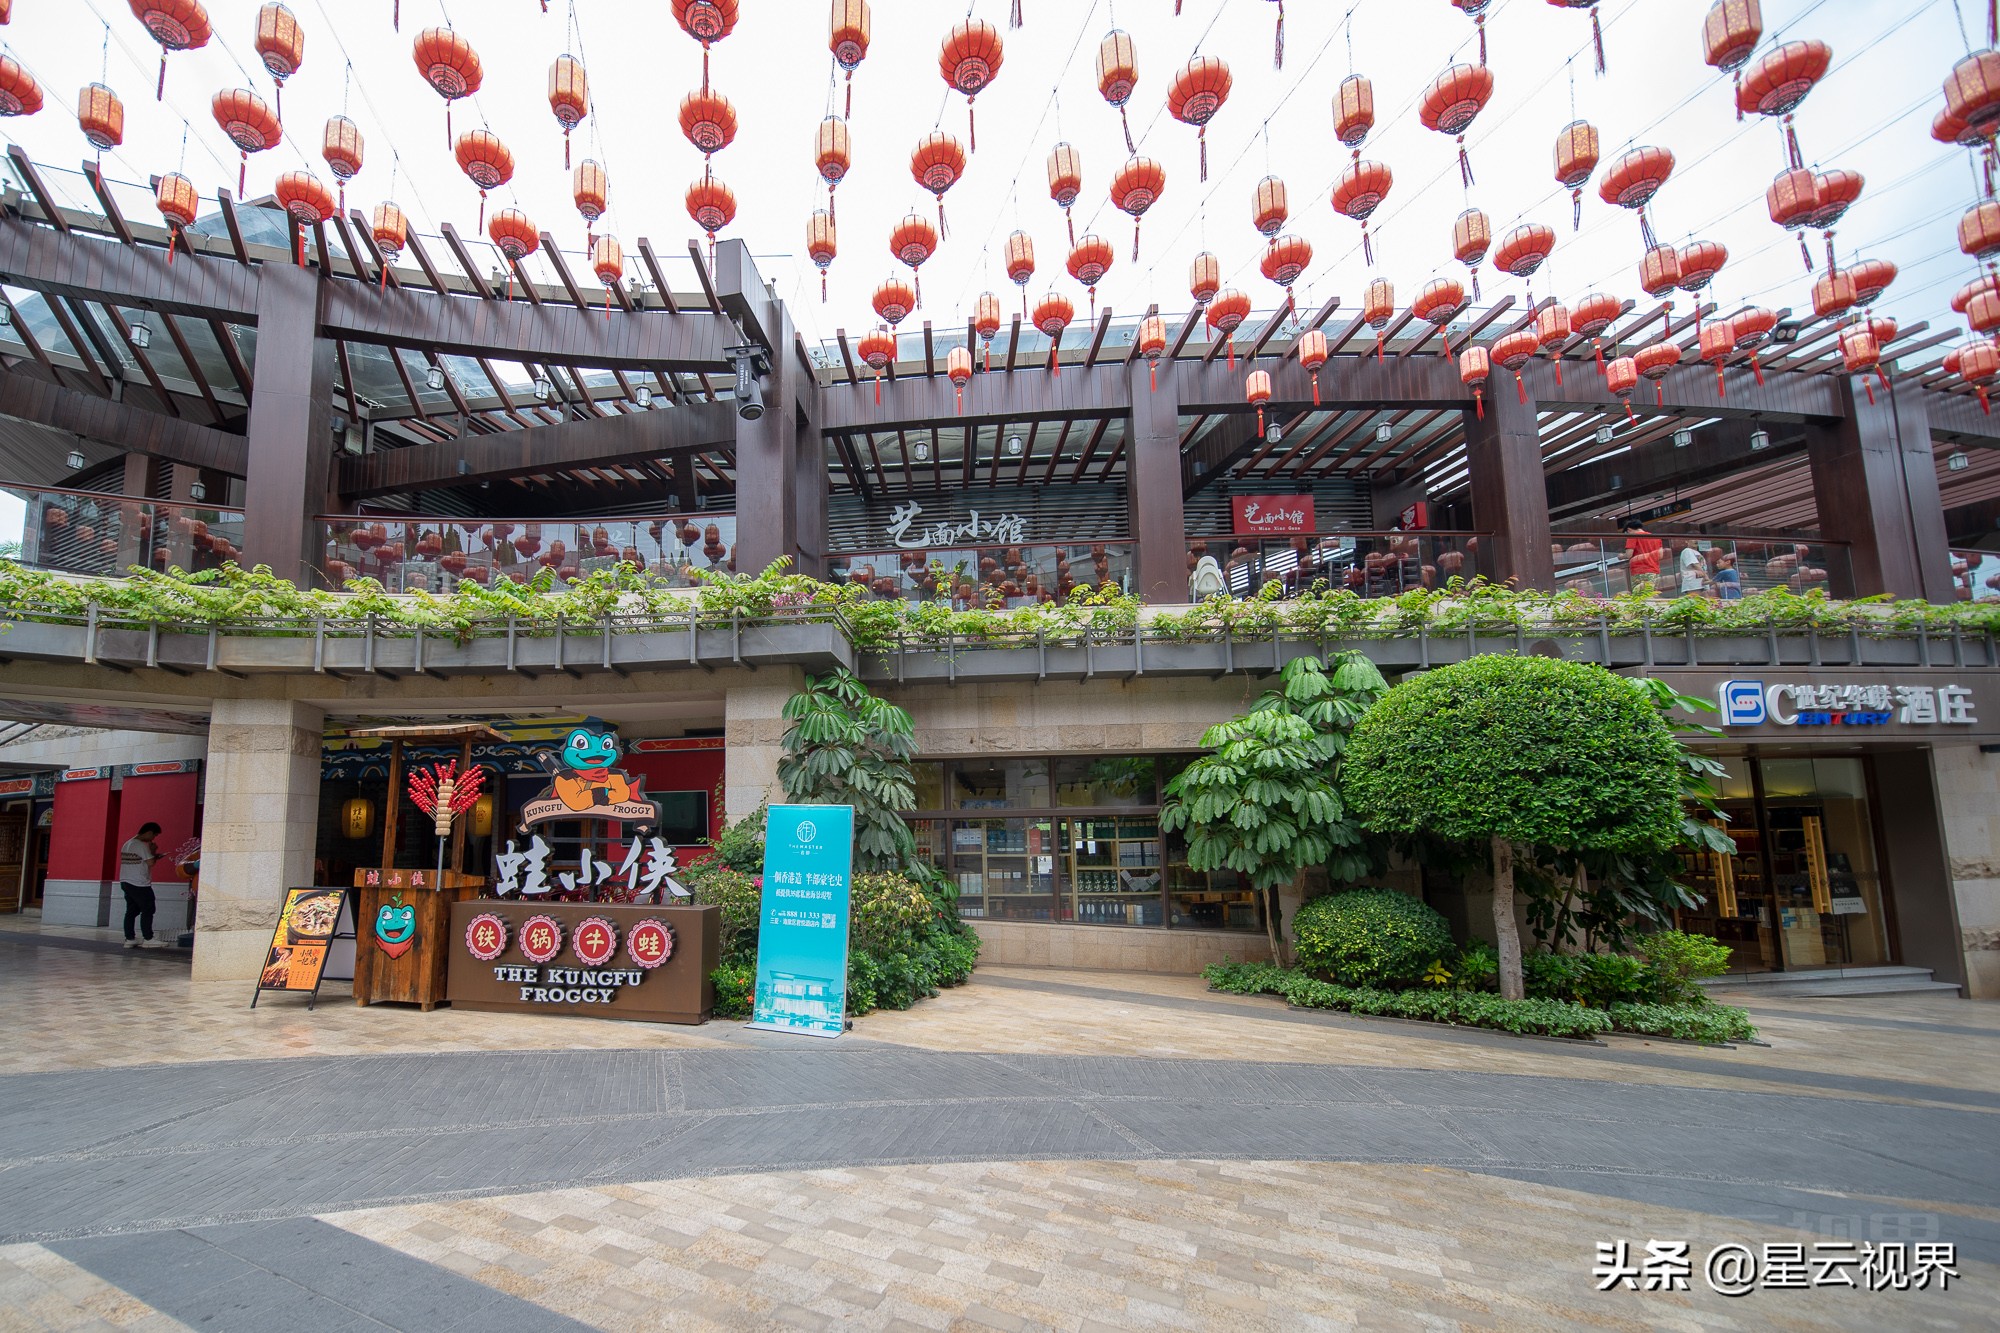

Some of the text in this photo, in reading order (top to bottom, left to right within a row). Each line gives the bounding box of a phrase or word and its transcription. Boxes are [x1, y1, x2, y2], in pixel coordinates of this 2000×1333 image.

[886, 500, 1027, 548] 艺面小馆
[1243, 502, 1305, 525] 艺面小馆
[525, 803, 651, 818] KUNGFU FROGGY
[495, 834, 691, 897] 蛙小侠
[366, 870, 426, 886] 蛙小侠
[475, 924, 661, 957] 铁锅牛蛙
[493, 967, 643, 986] THE KUNGFU
[519, 987, 615, 1003] FROGGY
